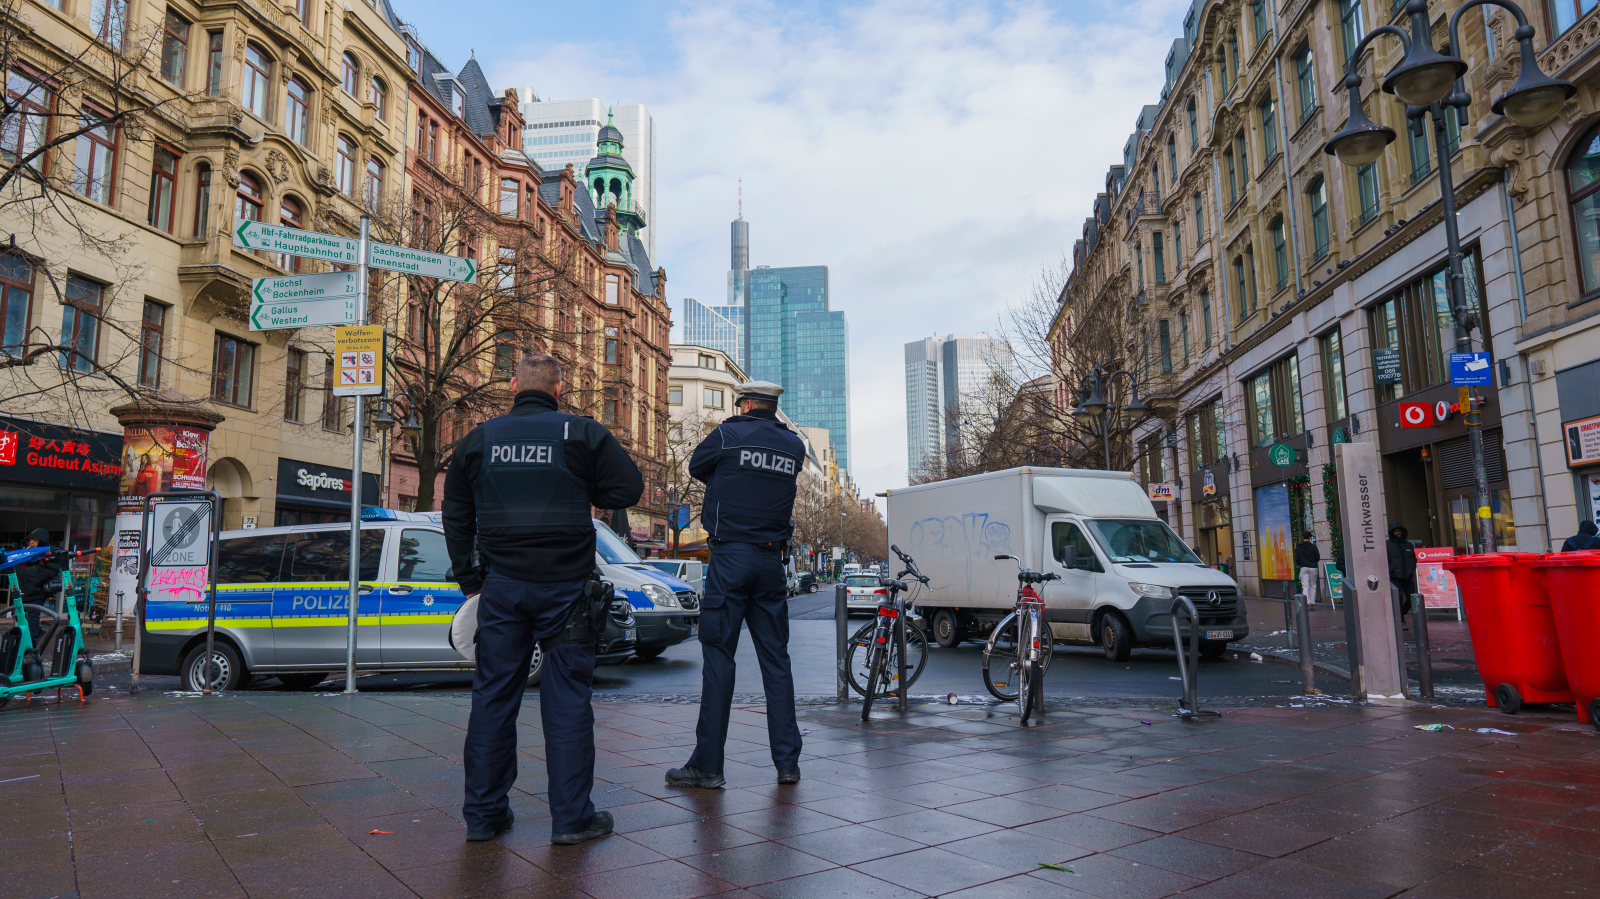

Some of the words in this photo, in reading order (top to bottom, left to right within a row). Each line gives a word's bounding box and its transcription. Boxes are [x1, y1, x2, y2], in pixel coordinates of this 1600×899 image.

[261, 226, 340, 248] Hbf-Fahrradparkhaus
[346, 242, 355, 250] 0,4
[274, 240, 342, 258] Hauptbahnhof
[374, 246, 442, 264] Sachsenhausen
[372, 256, 420, 270] Innenstadt
[273, 279, 302, 288] Höchst
[272, 288, 324, 298] Bockenheim
[271, 315, 308, 325] Westend
[182, 430, 198, 438] Kiew
[27, 452, 79, 470] Gutleut
[491, 445, 552, 464] POLIZEI
[740, 450, 796, 476] POLIZEI
[297, 468, 344, 490] Sapôres
[1155, 486, 1170, 494] dm
[1358, 474, 1375, 552] Trinkwasser
[164, 552, 194, 562] ZONE
